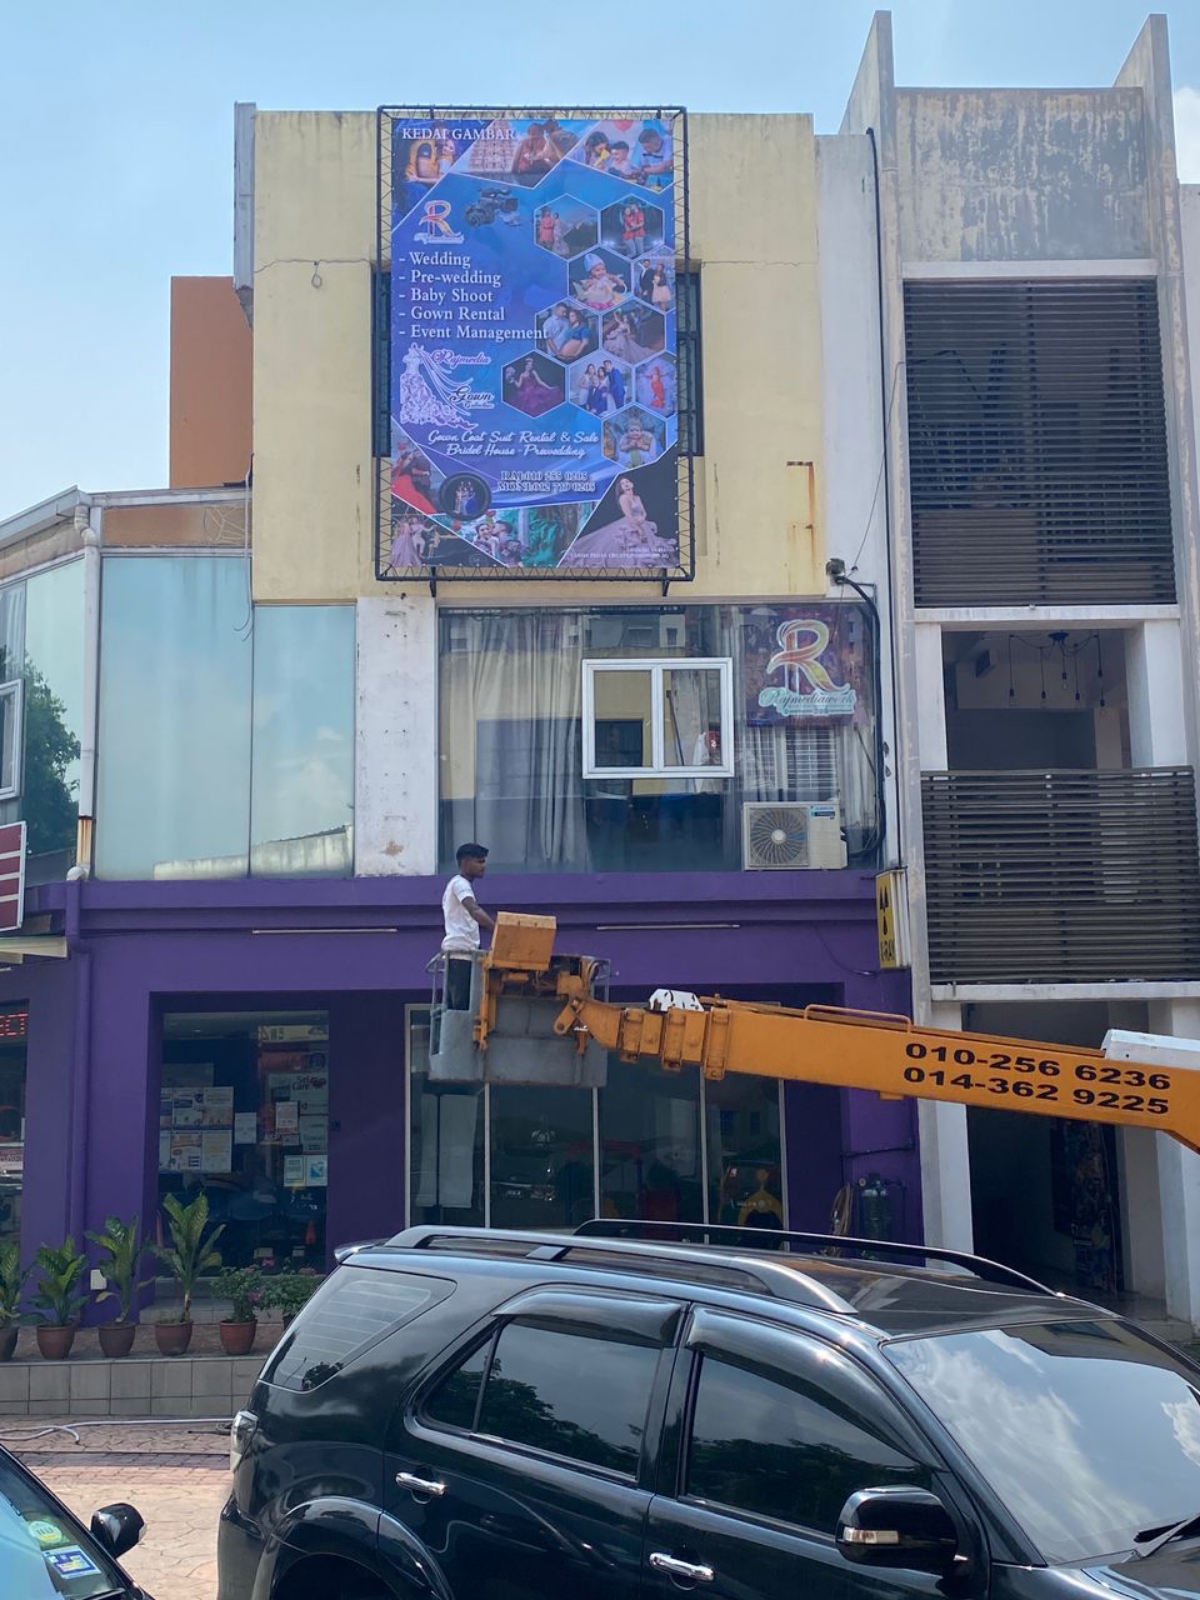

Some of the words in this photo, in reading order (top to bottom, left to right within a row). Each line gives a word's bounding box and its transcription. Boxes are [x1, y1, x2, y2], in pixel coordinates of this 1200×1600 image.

[402, 128, 447, 140] KEDAI
[452, 128, 516, 140] GAMBAR
[409, 251, 471, 269] Wedding
[411, 269, 502, 287] Pre-wedding
[411, 288, 446, 305] Baby
[451, 288, 493, 302] Shoot
[411, 306, 453, 320] Gown
[459, 306, 505, 321] Rental
[411, 325, 451, 338] Event
[456, 325, 548, 343] Management
[428, 430, 460, 444] Gown
[489, 431, 515, 443] Suit
[519, 431, 556, 443] Rental
[560, 431, 570, 442] &
[574, 431, 599, 444] Sale
[484, 444, 516, 456] House
[905, 1043, 1061, 1077] 010-256
[1075, 1064, 1171, 1091] 6236
[903, 1067, 1059, 1101] 014-362
[1073, 1088, 1170, 1115] 9225
